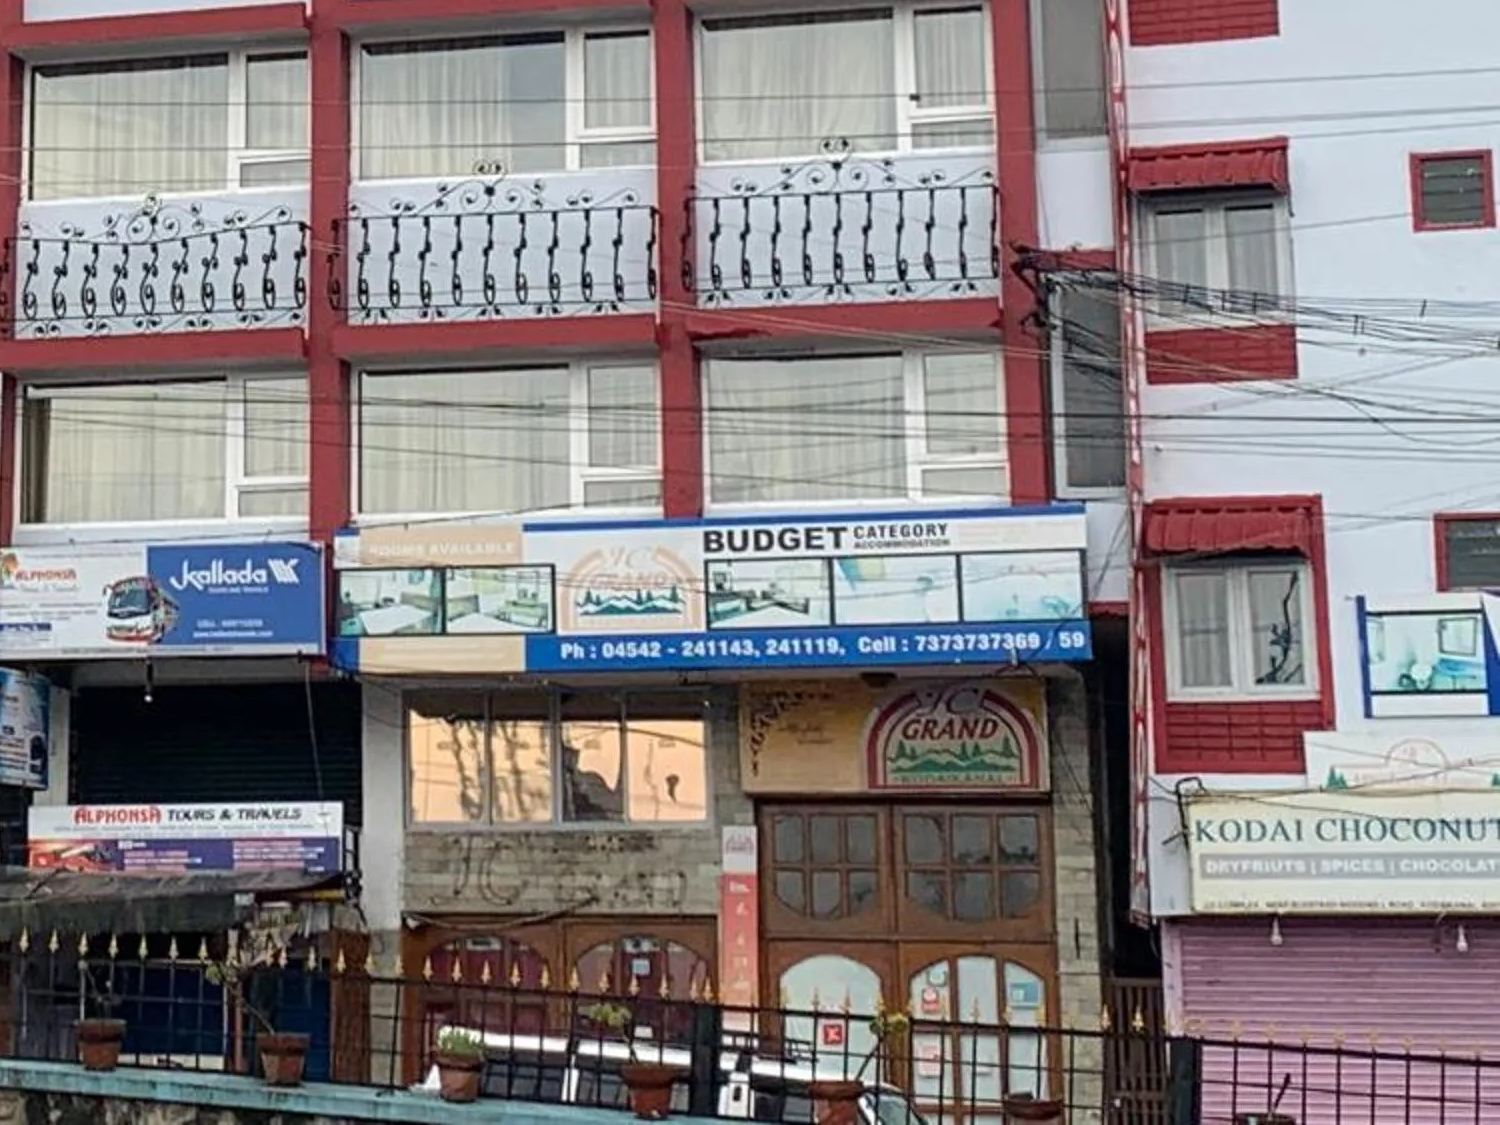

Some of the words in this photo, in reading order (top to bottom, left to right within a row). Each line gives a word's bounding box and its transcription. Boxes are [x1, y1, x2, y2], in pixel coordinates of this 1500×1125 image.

[703, 526, 847, 554] BUDGET
[853, 523, 948, 539] CATEGORY
[427, 541, 515, 555] AVAILABLE
[560, 643, 584, 659] Ph
[602, 642, 661, 659] 04542
[681, 640, 760, 658] 241143,
[857, 635, 897, 654] Cell
[1058, 630, 1085, 649] 59
[915, 688, 979, 716] JC
[902, 717, 1000, 741] GRAND
[74, 805, 161, 825] ALPHONSA
[168, 808, 214, 822] TOURS
[219, 808, 232, 821] &
[238, 807, 301, 821] TRAVELS
[1194, 818, 1304, 843] KODAI
[1314, 817, 1500, 843] CHOCONUT
[1320, 858, 1385, 873] SPICES
